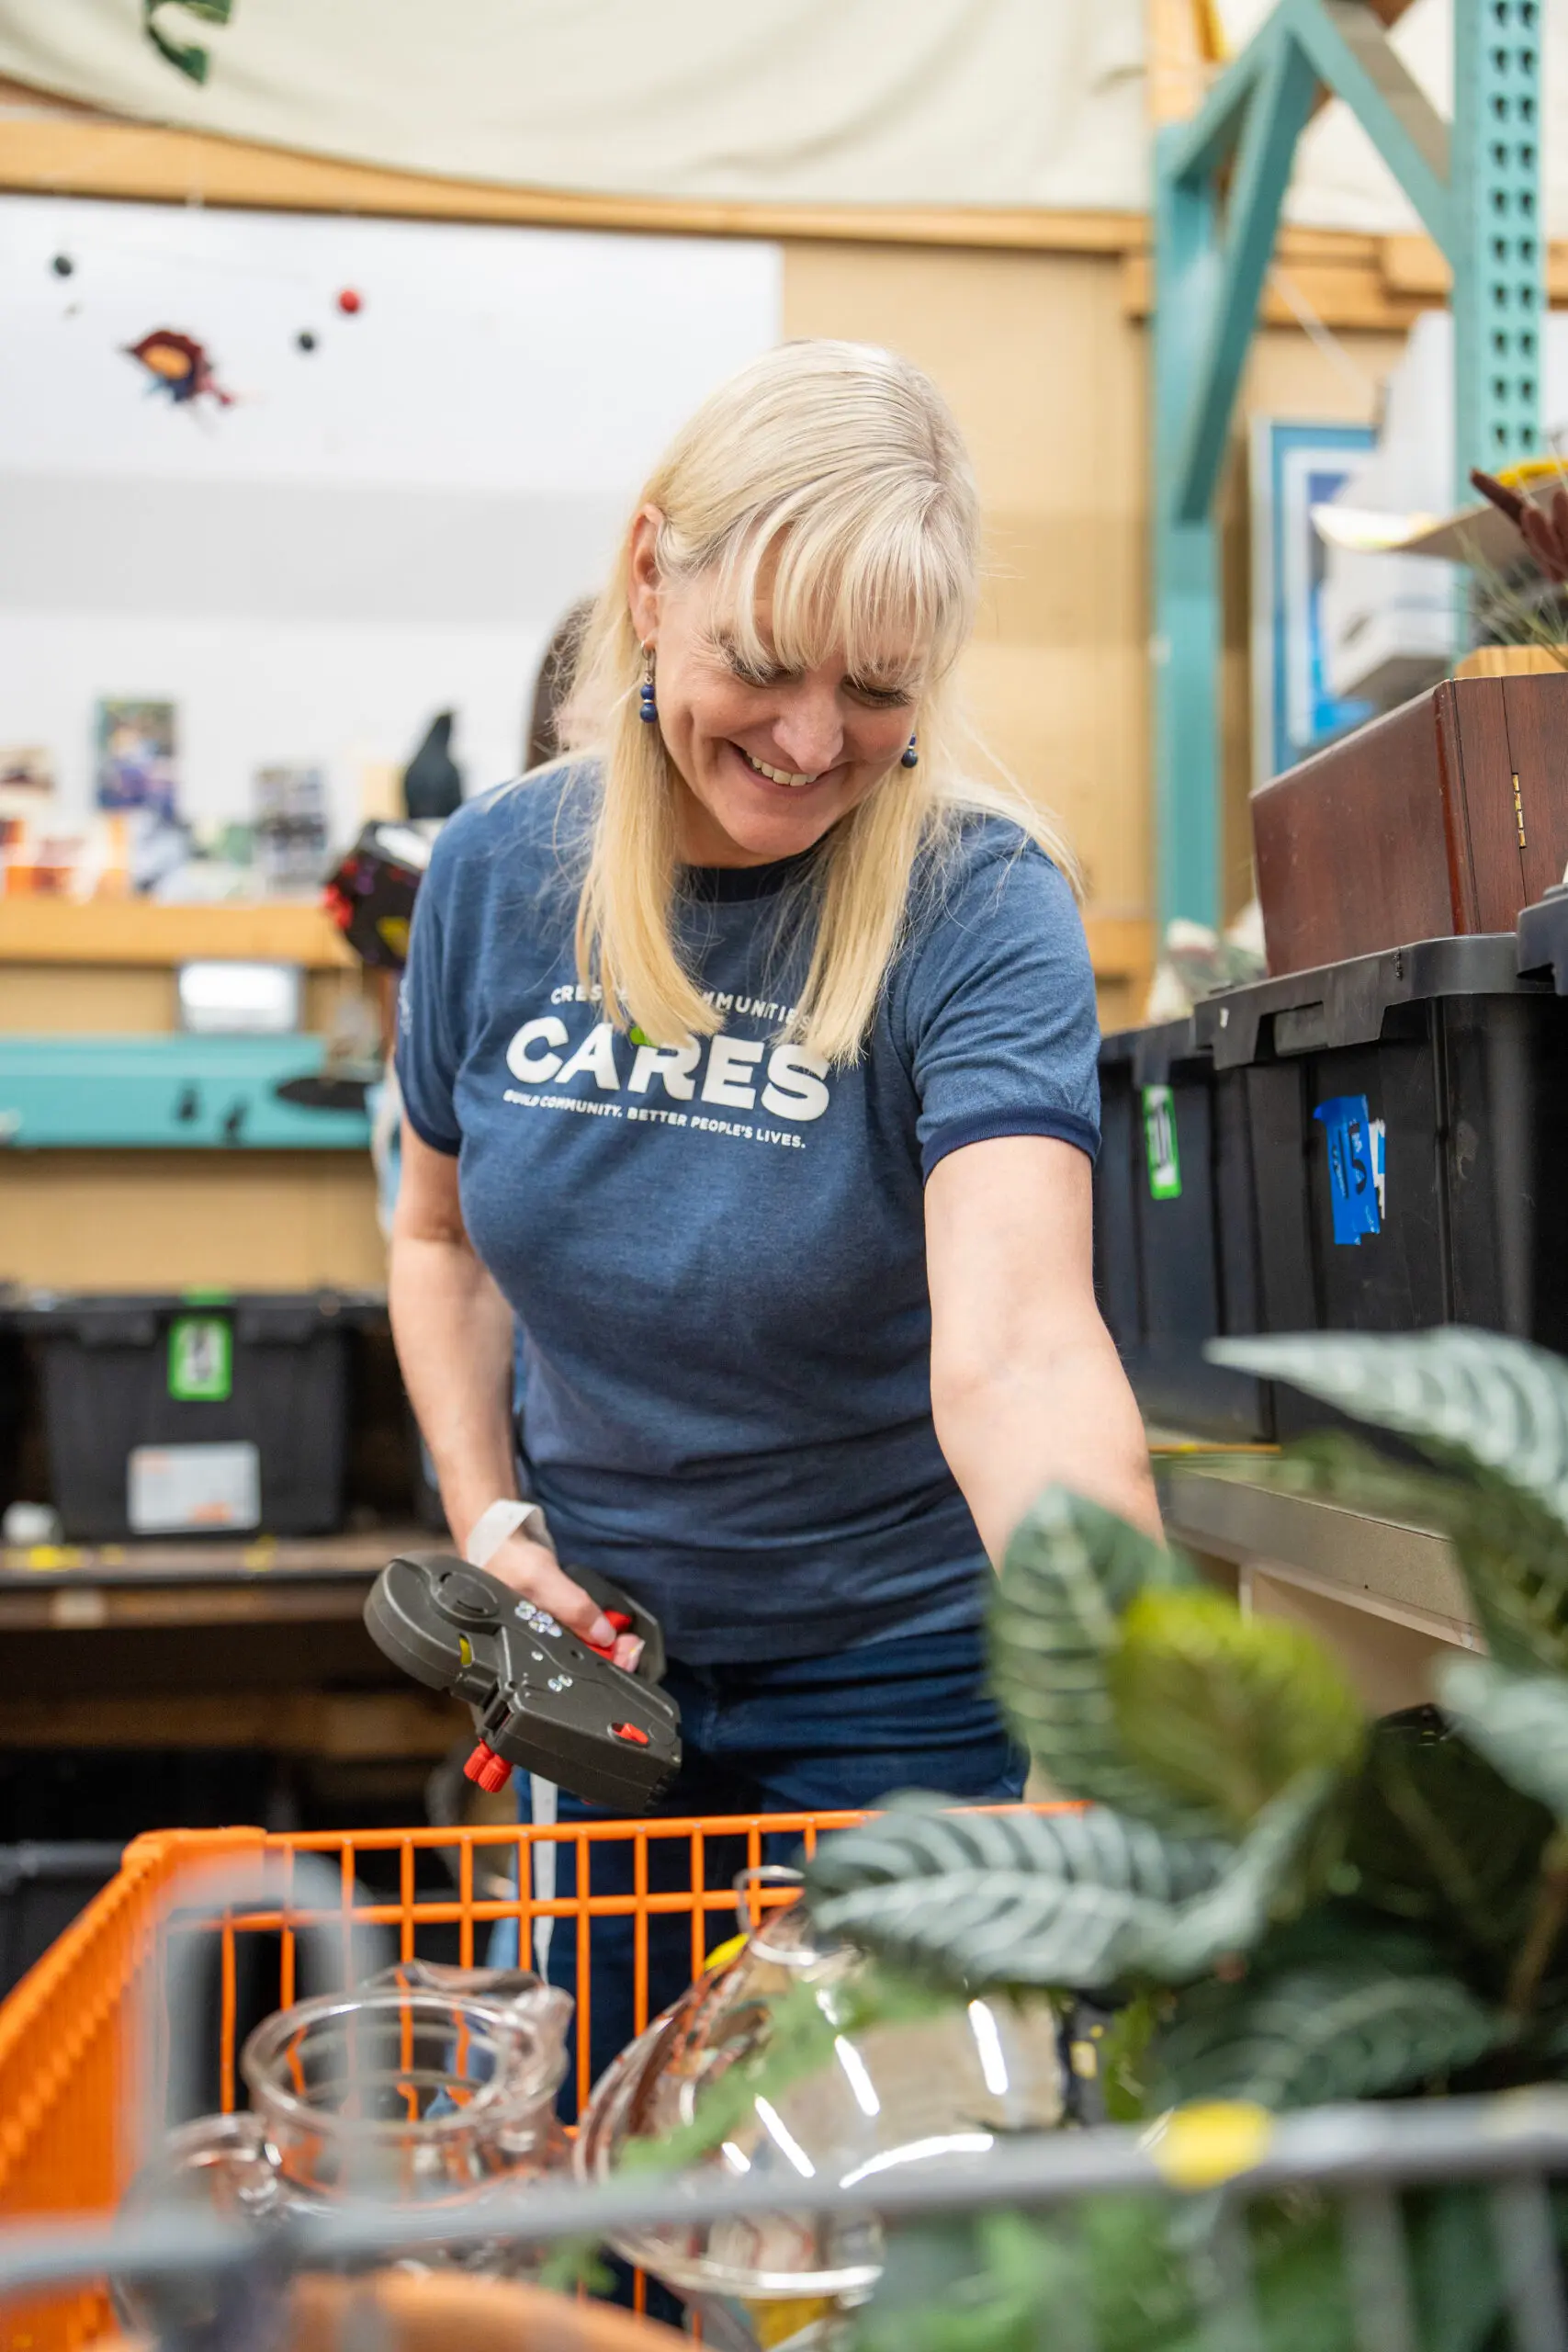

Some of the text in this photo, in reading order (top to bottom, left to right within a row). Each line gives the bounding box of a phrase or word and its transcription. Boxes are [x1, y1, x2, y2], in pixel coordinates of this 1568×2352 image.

[505, 1015, 830, 1122] CARES
[502, 1089, 807, 1148] BUILD COMMUNITY. BETTER PEOPLE'S LIVES.
